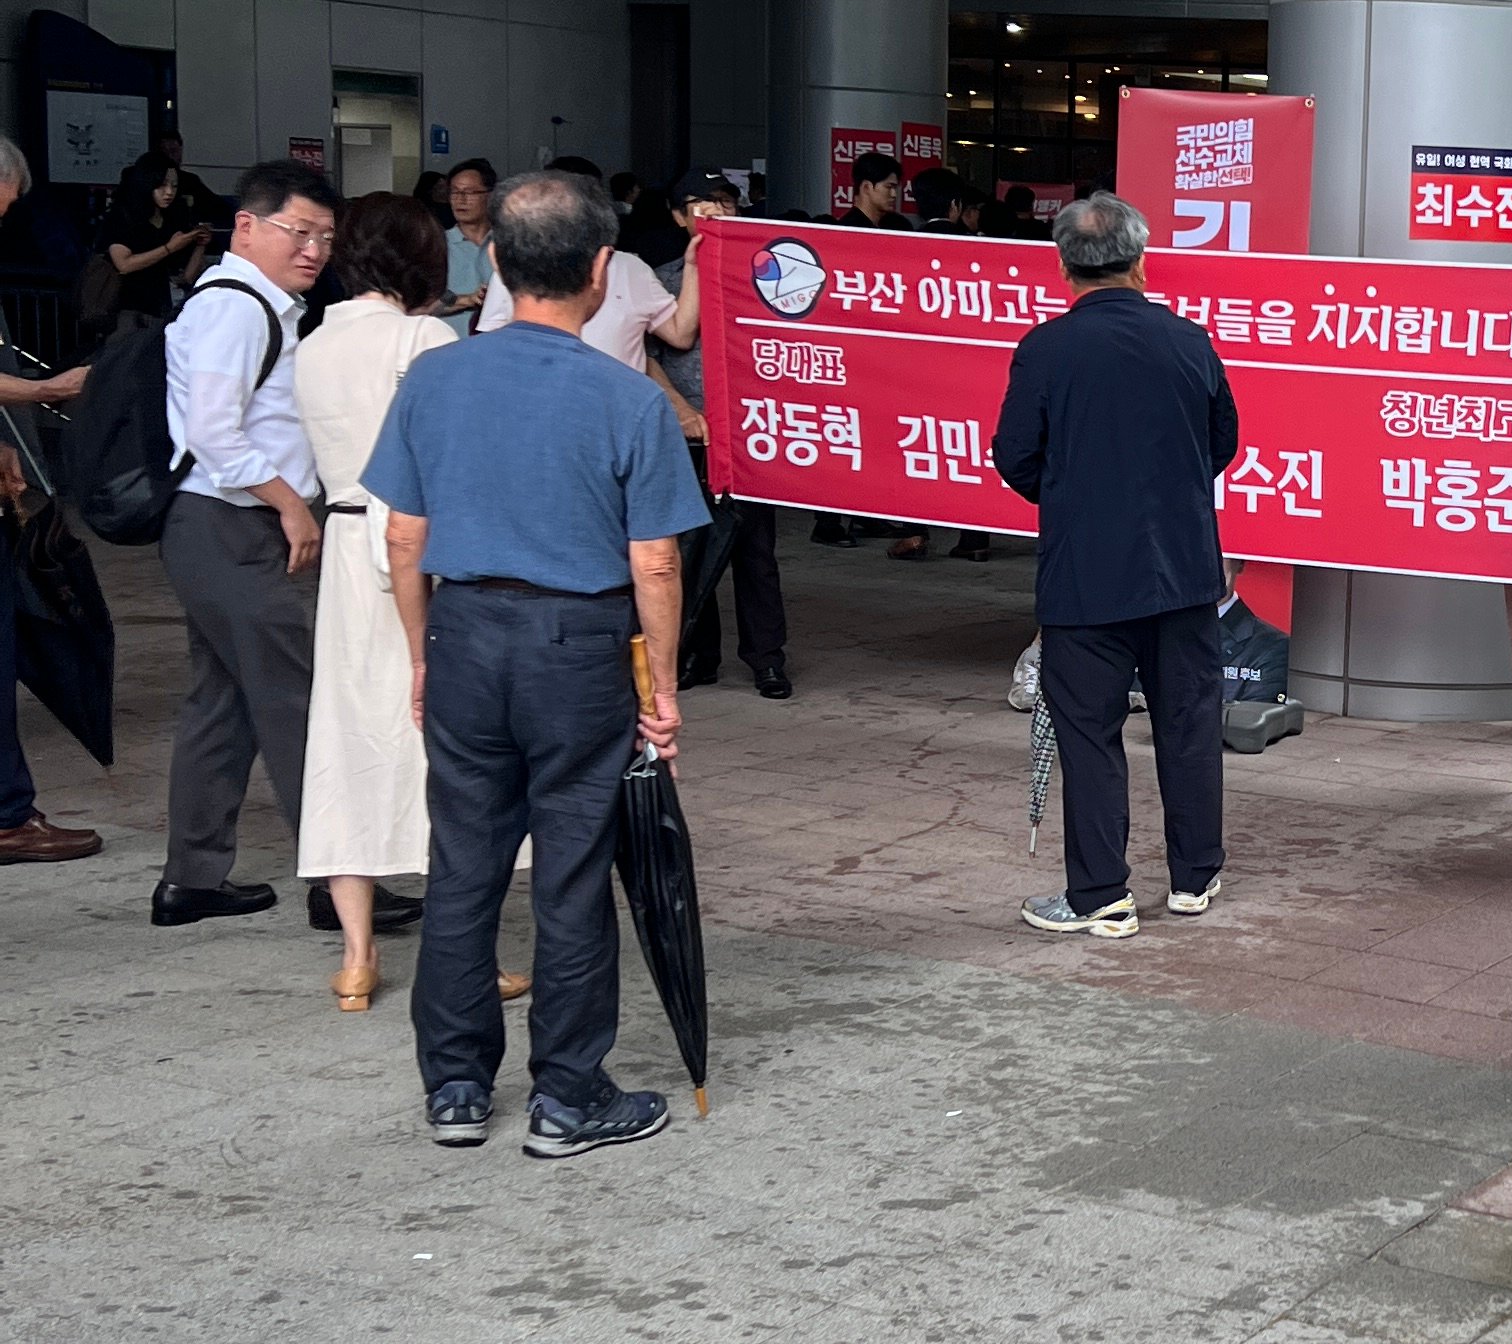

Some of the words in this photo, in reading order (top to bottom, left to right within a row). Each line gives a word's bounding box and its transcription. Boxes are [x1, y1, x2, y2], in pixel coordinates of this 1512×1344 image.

[1176, 118, 1254, 148] 국민의힘
[1175, 141, 1253, 172] 선수교체
[1415, 153, 1440, 167] 유일!
[1444, 154, 1466, 168] 여성
[1469, 155, 1491, 169] 현역
[1175, 170, 1218, 190] 확실한
[1218, 164, 1253, 187] 선택!
[829, 269, 907, 314] 부산
[918, 275, 1071, 325] 아미고는
[751, 338, 846, 385] 당대표
[741, 397, 862, 472] 장동혁
[898, 415, 1010, 488] 김민
[1240, 667, 1261, 682] 후보
